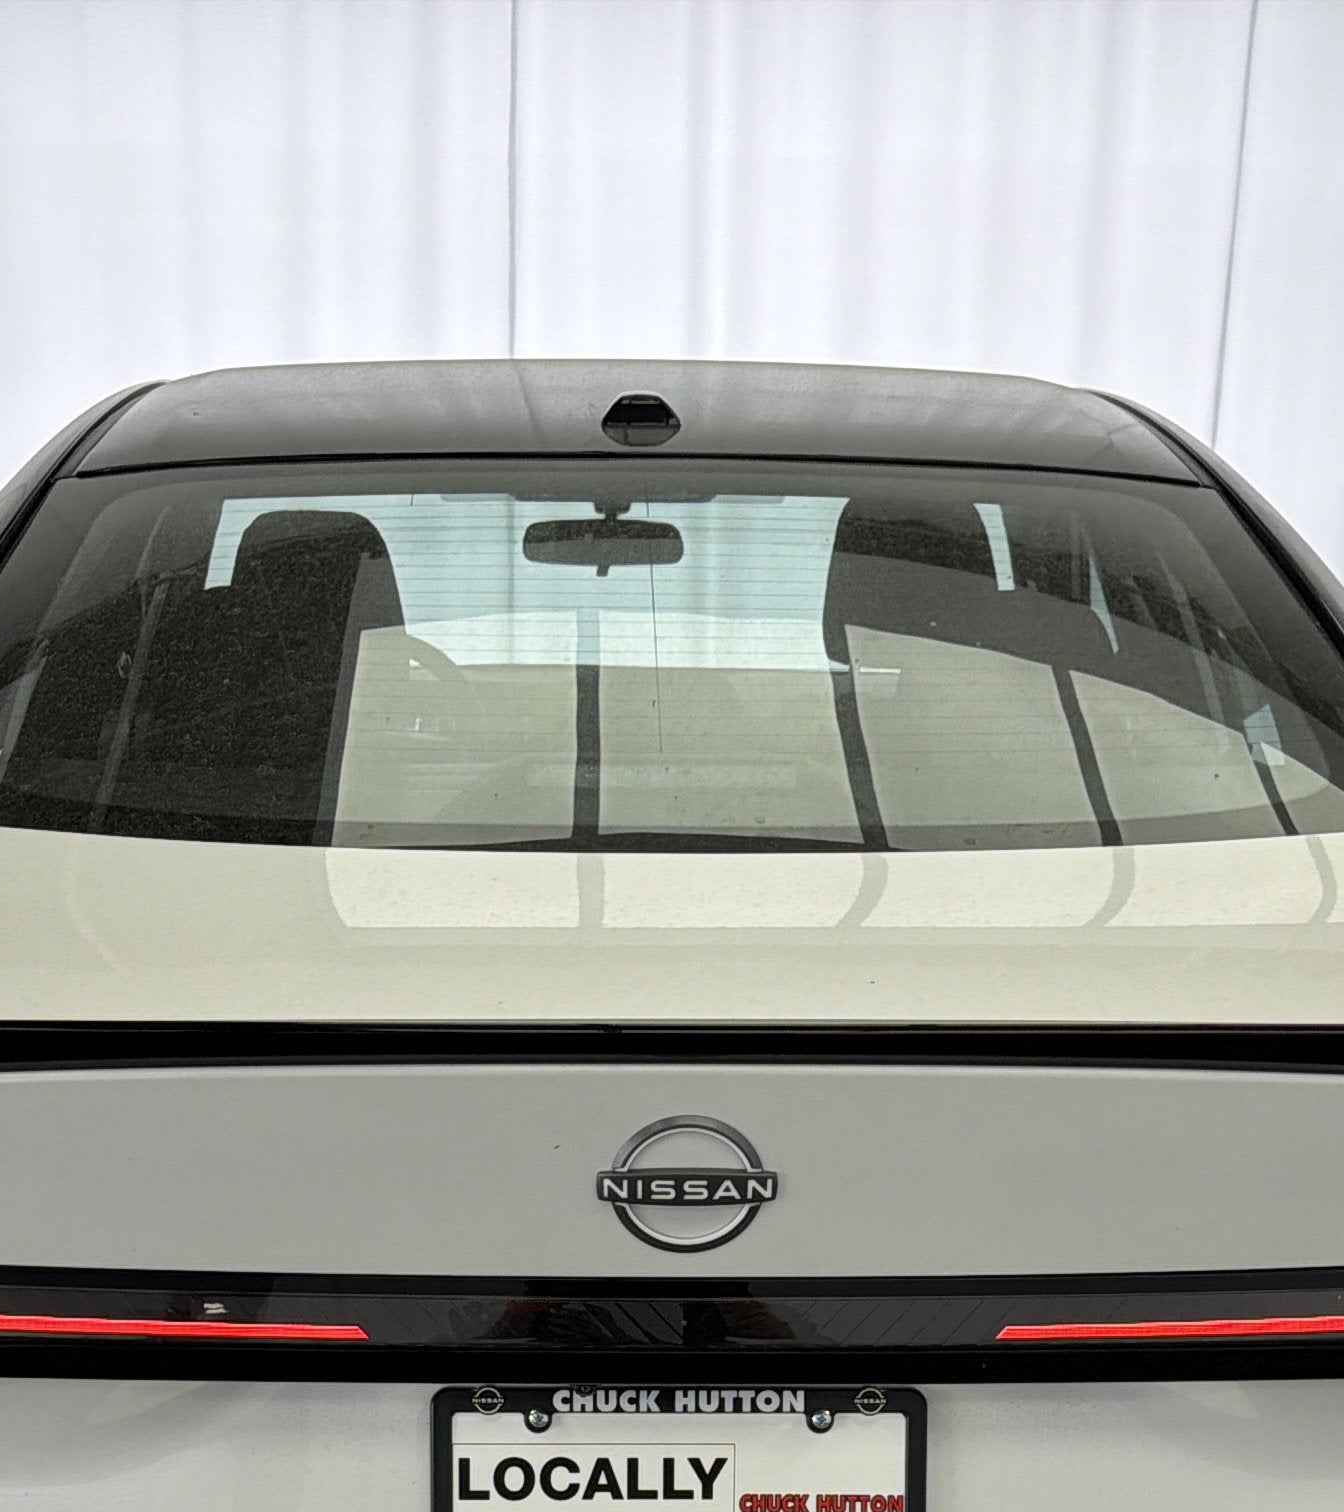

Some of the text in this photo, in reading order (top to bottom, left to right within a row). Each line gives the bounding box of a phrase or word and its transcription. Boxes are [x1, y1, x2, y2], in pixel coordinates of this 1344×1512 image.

[602, 1178, 773, 1201] NISSAN
[552, 1389, 805, 1413] CHUCK HUTTON
[457, 1457, 728, 1501] LOCALLY
